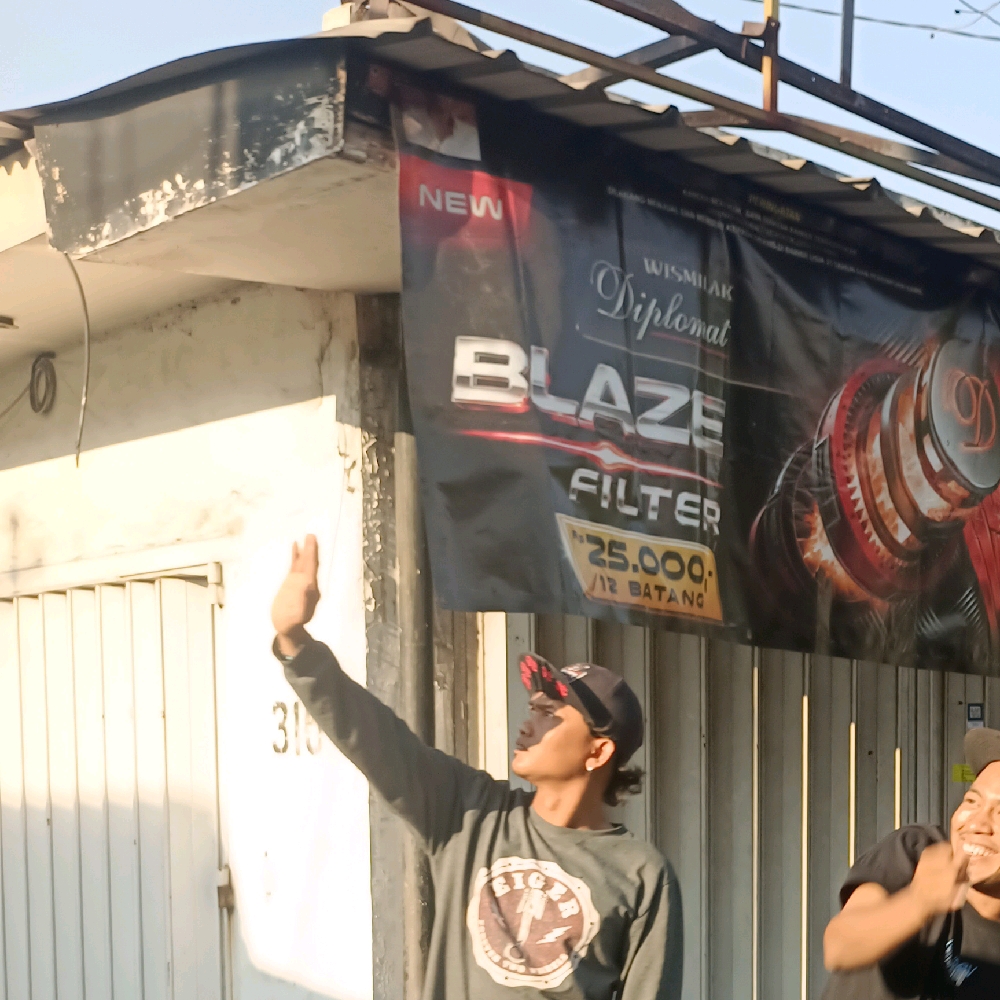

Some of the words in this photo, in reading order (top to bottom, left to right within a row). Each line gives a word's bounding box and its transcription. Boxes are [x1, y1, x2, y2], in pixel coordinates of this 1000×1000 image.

[418, 184, 503, 221] NEW
[590, 259, 732, 348] Diplomat
[644, 257, 734, 301] WISMILAK
[451, 334, 727, 458] BLAZE
[568, 467, 722, 536] FILTER
[491, 870, 581, 919] EIGER
